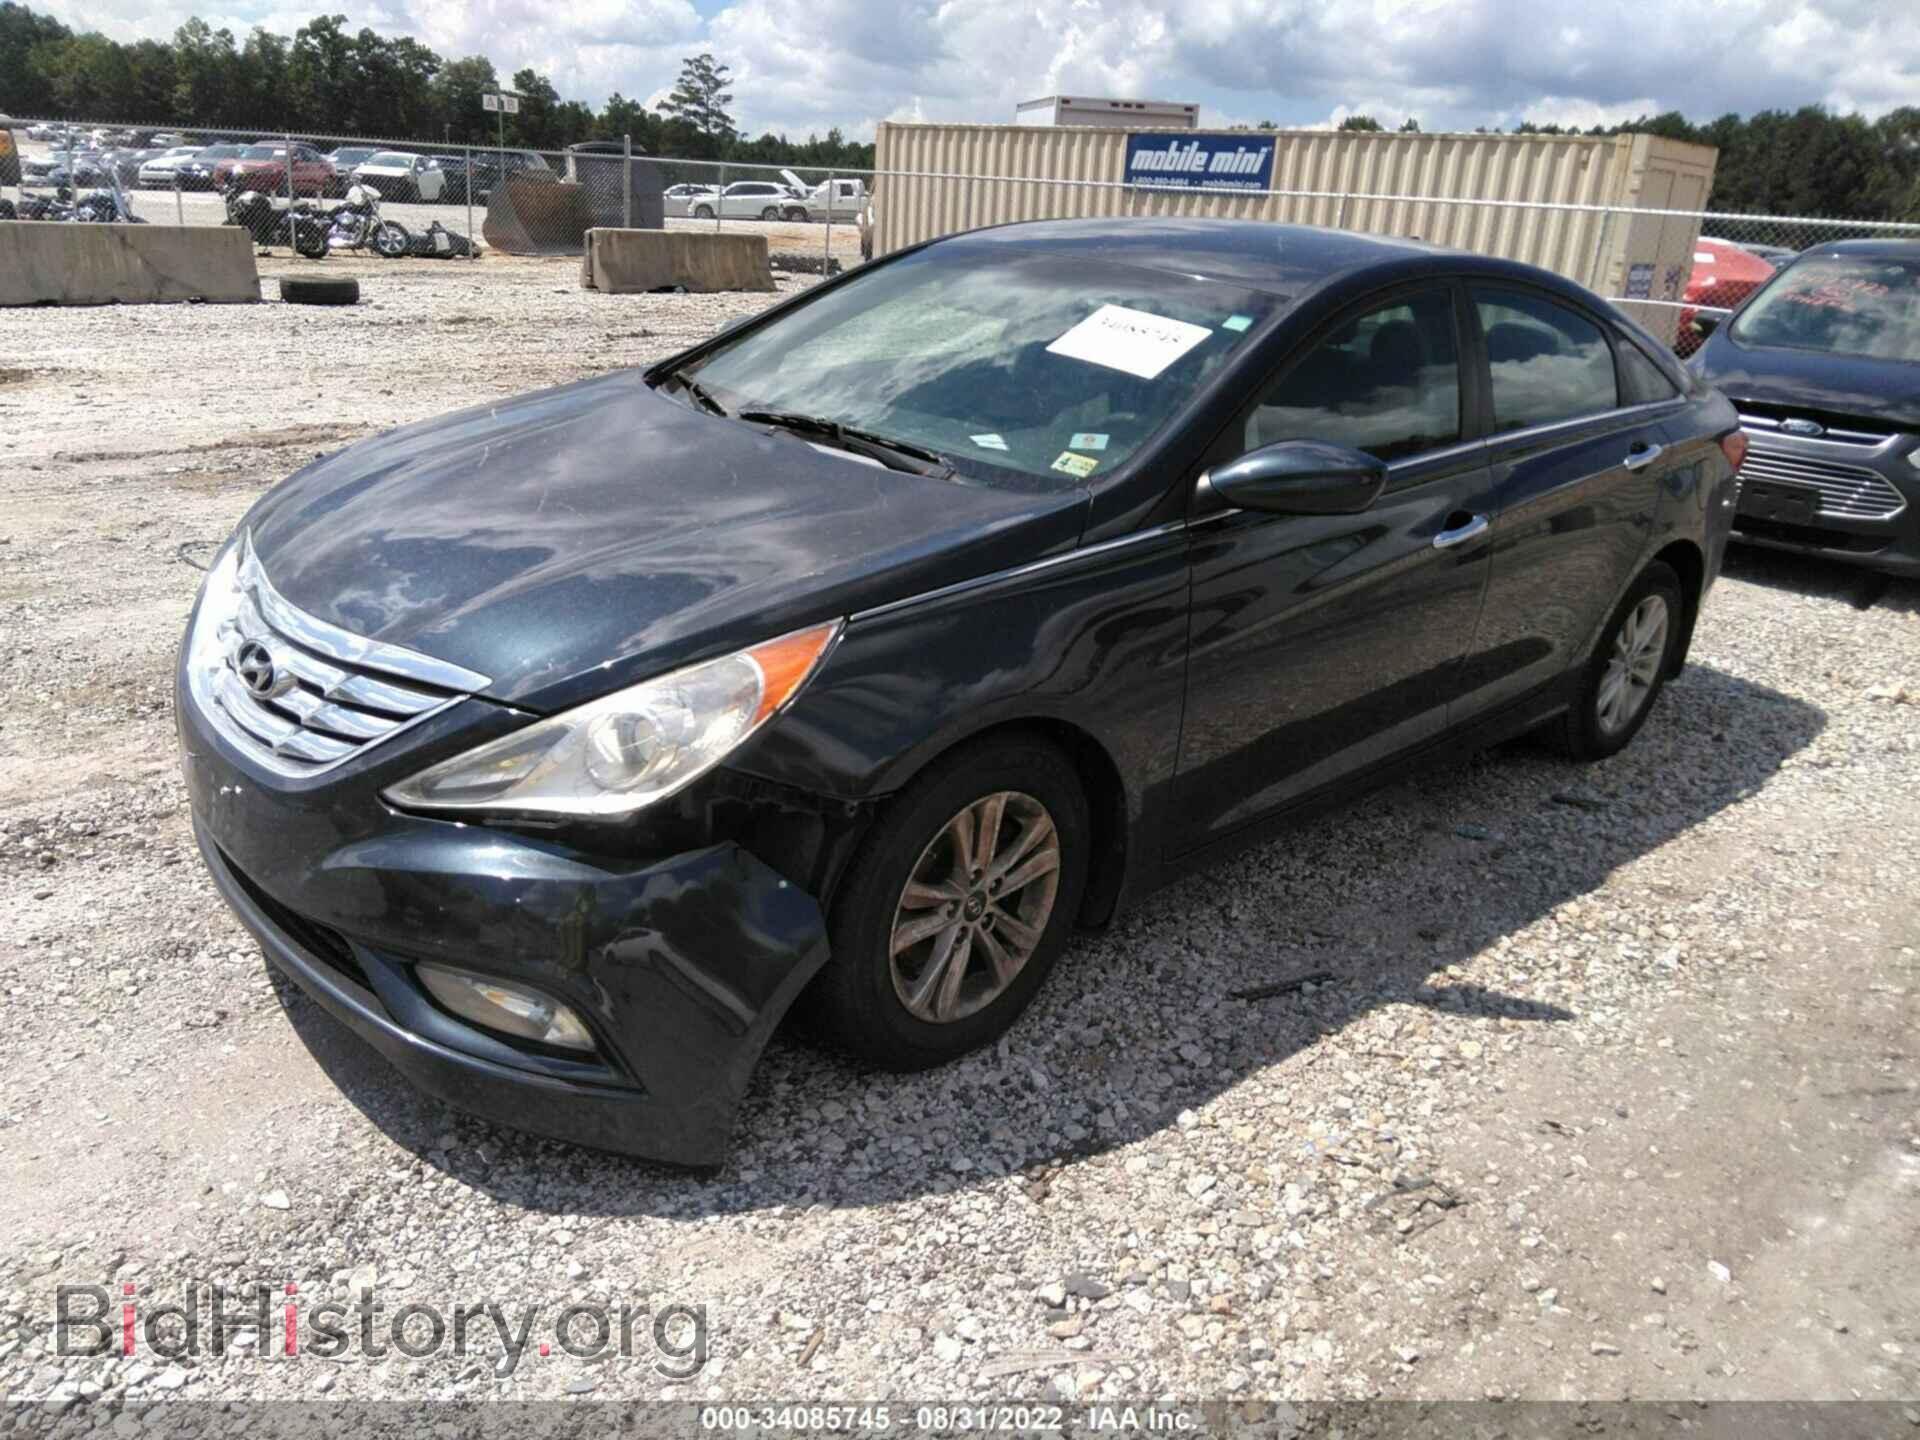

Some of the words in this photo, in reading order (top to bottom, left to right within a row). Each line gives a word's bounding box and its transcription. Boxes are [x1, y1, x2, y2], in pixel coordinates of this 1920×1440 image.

[486, 95, 496, 108] A
[507, 98, 515, 111] B
[1130, 140, 1209, 172] mobile
[1208, 146, 1268, 174] mini
